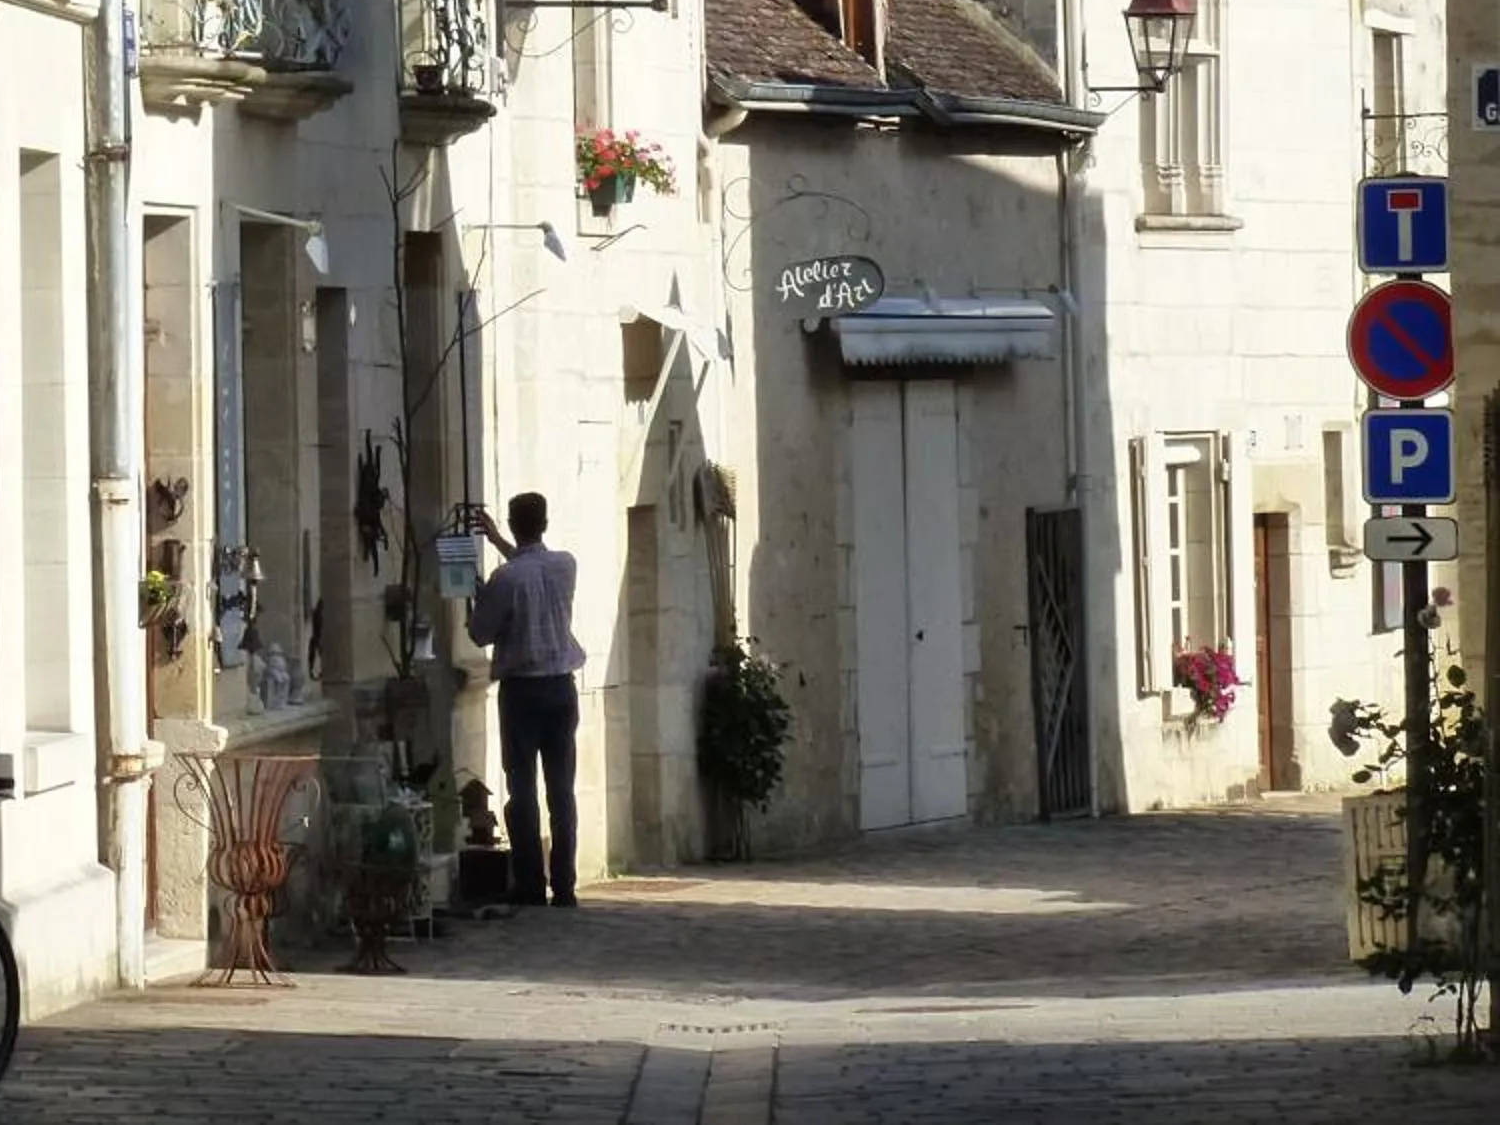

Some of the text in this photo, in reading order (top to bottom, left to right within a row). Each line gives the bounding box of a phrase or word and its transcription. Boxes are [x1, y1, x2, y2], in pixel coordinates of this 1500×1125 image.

[776, 260, 852, 303] Atelier
[816, 278, 875, 310] d'Art
[1390, 428, 1429, 484] P
